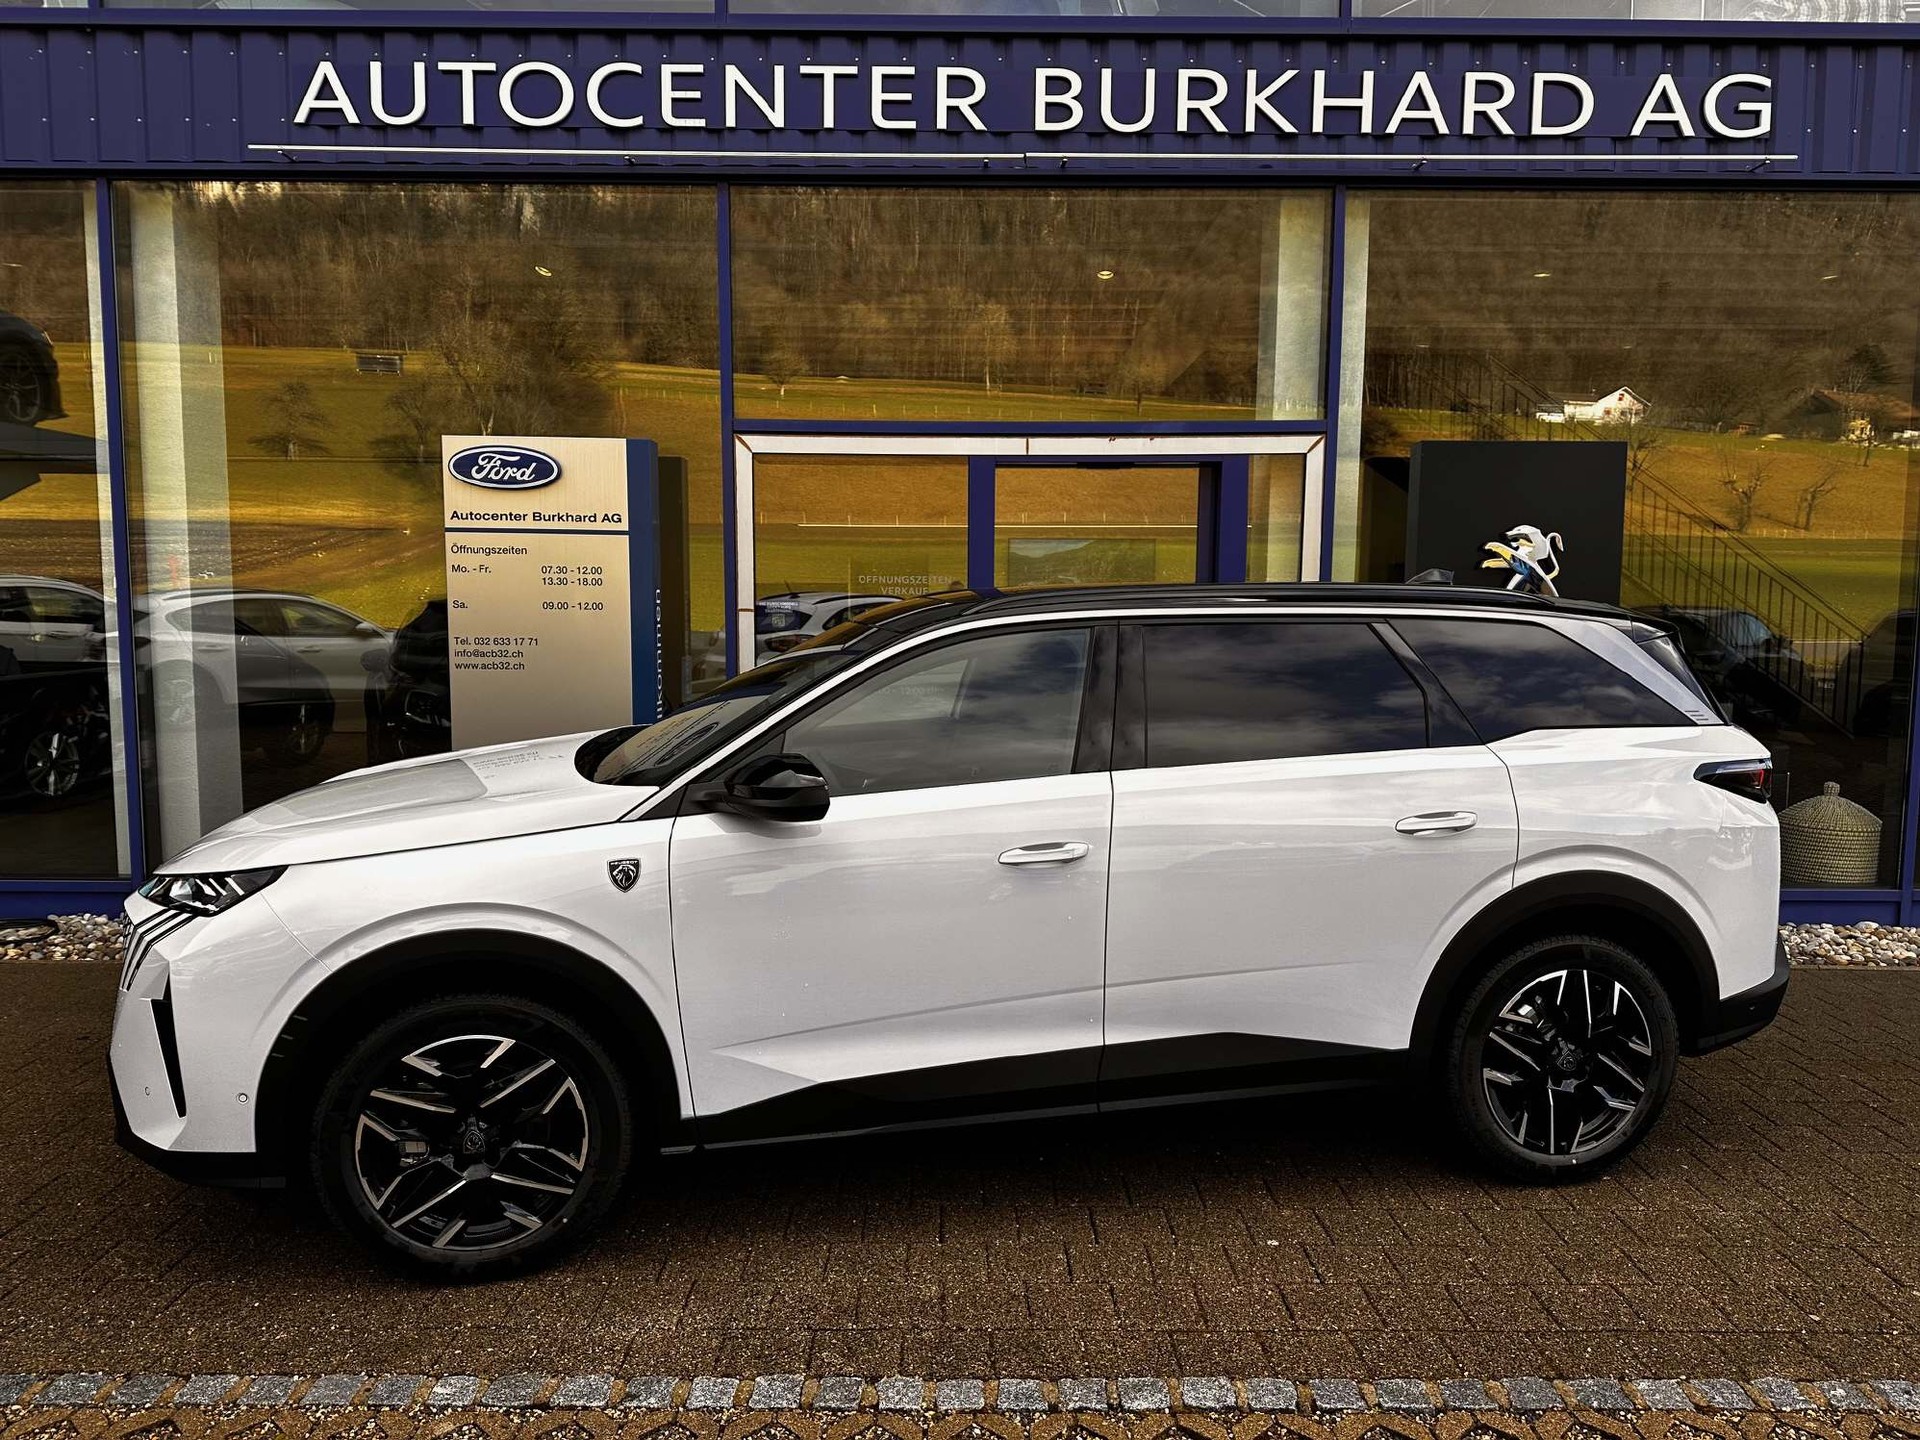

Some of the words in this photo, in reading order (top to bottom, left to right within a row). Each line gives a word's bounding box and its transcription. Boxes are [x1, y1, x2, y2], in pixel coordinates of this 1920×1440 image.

[293, 60, 988, 132] AUTOCENTER
[1034, 67, 1596, 137] BURKHARD
[1629, 73, 1773, 140] AG
[471, 452, 538, 481] Ford
[450, 510, 528, 522] Autocenter
[532, 511, 597, 523] Burkhard
[601, 513, 623, 523] AG
[450, 543, 528, 556] Öffnungszeiten
[451, 564, 470, 574] Mo.
[479, 565, 492, 574] Fr.
[541, 565, 568, 575] 07.30
[576, 566, 603, 575] 12.00
[542, 577, 568, 586] 13.30
[577, 578, 603, 587] 18.00
[881, 586, 929, 596] VERKAUF
[452, 600, 469, 609] Sa.
[542, 602, 569, 611] 09.00
[578, 602, 604, 611] 12.00
[454, 637, 471, 646] Tel.
[473, 637, 491, 646] 032
[493, 637, 511, 646] 633
[513, 637, 525, 646] 17
[528, 637, 538, 646] 71
[454, 649, 524, 658] info@acb32.ch
[455, 661, 525, 670] www.acb32.ch
